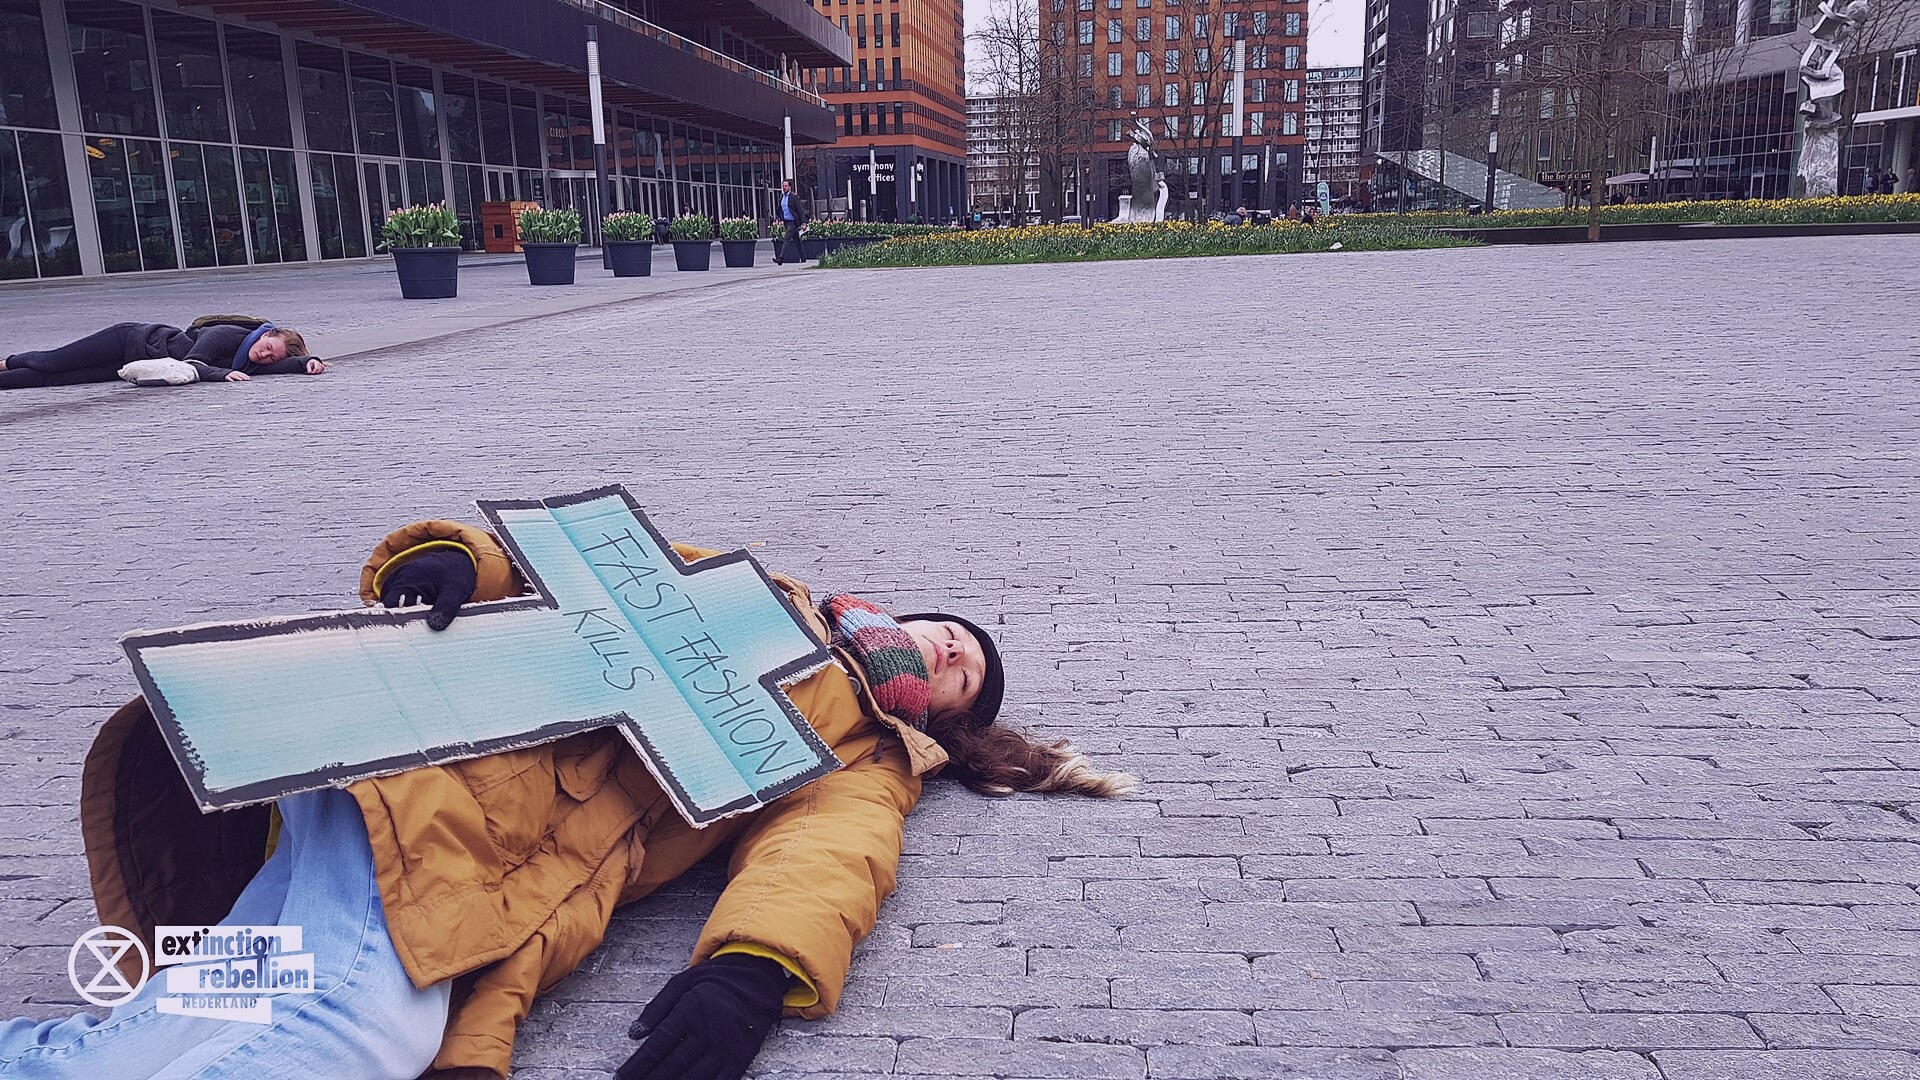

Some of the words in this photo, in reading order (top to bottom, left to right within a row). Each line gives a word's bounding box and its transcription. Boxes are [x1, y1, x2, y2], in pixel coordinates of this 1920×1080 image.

[852, 162, 894, 173] symhony
[1541, 171, 1554, 180] the
[562, 607, 654, 690] KILLS
[581, 528, 704, 623] FAST
[665, 631, 807, 774] FASHION
